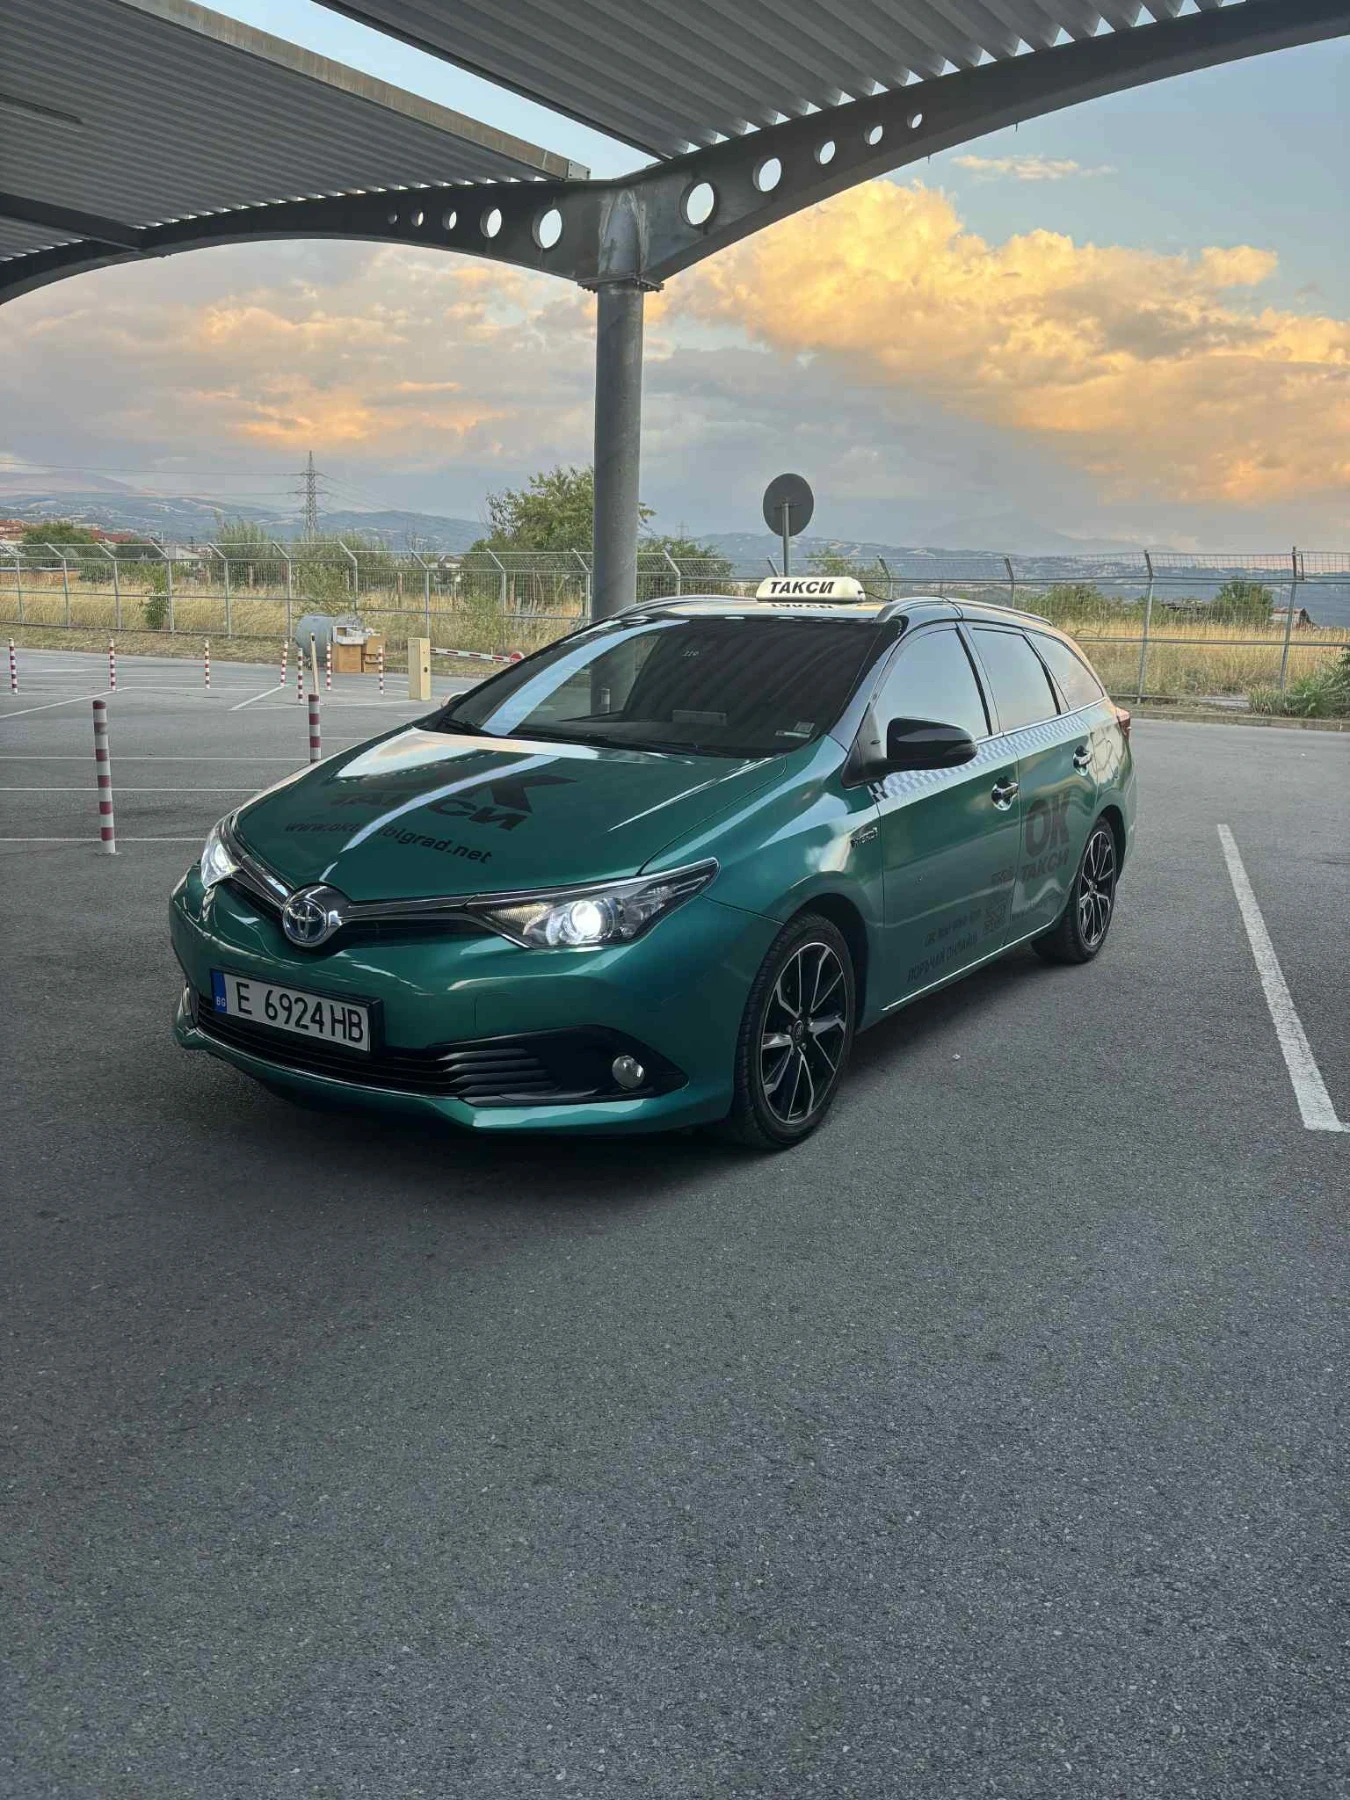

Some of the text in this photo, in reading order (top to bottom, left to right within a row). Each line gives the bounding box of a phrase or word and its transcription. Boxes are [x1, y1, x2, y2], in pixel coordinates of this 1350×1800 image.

[771, 581, 836, 594] ТАКСИ
[1024, 793, 1070, 858] OK
[1021, 847, 1070, 883] ТАКСИ
[215, 996, 227, 1007] BG
[235, 981, 364, 1043] E 6924 HB
